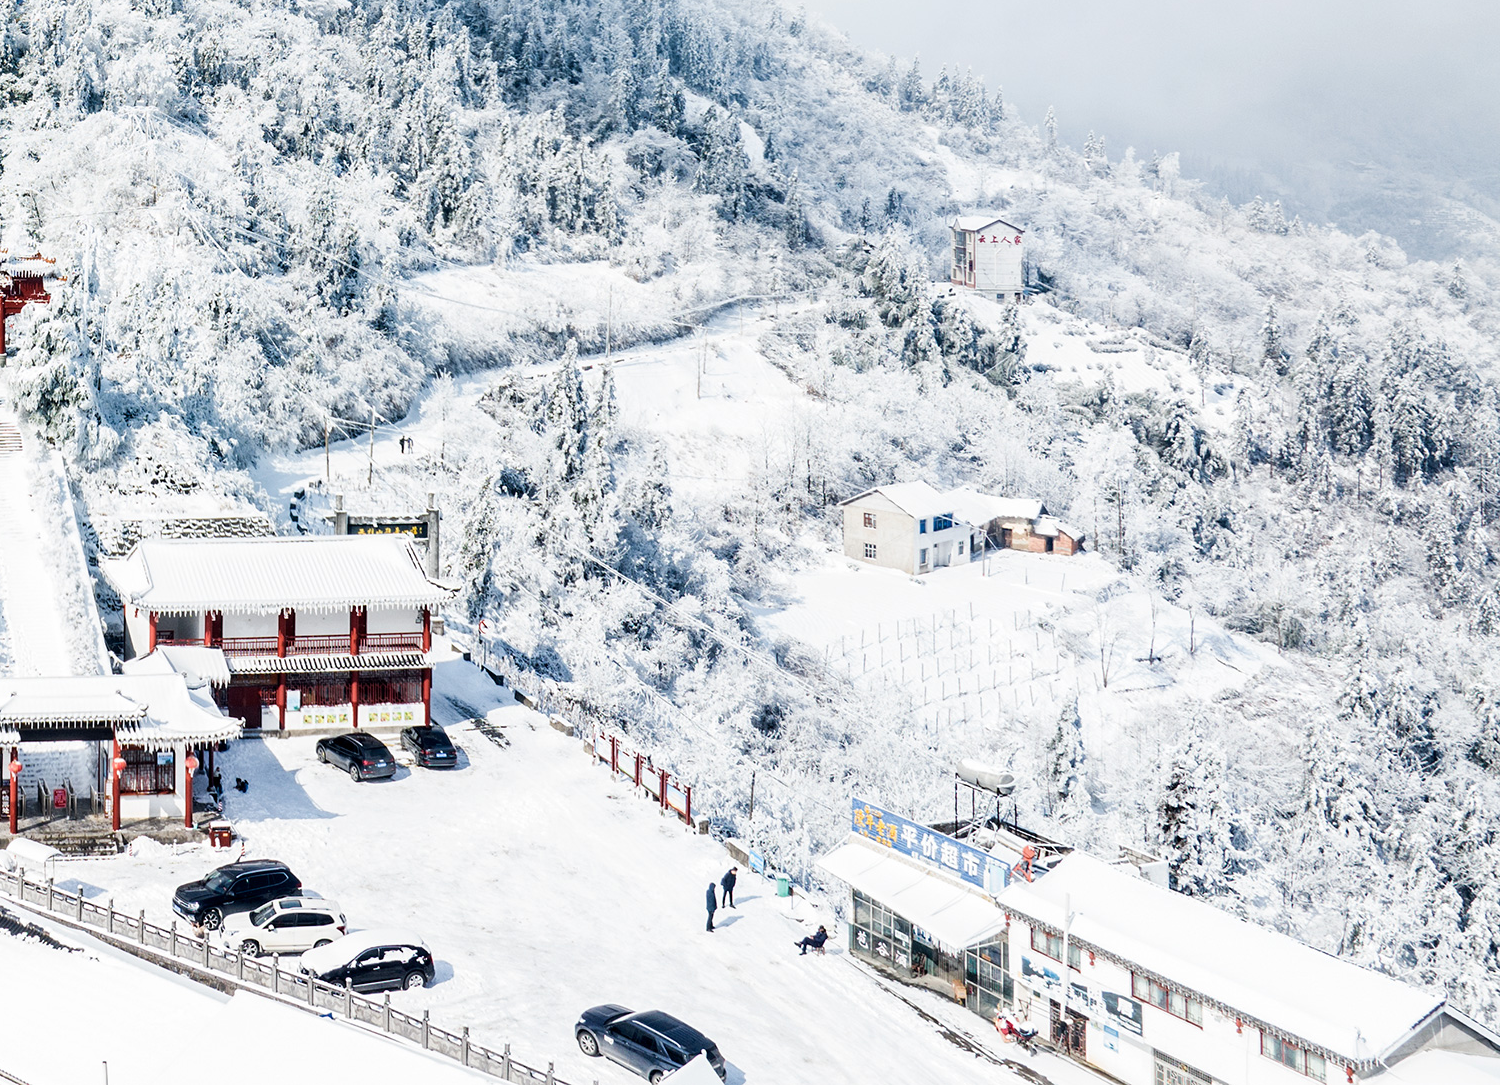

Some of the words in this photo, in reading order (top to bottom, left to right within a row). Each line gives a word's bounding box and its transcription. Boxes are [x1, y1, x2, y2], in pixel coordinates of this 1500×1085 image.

[978, 234, 1022, 246] 云上人家
[901, 823, 980, 878] 平价超市
[856, 930, 908, 969] 苞谷酒
